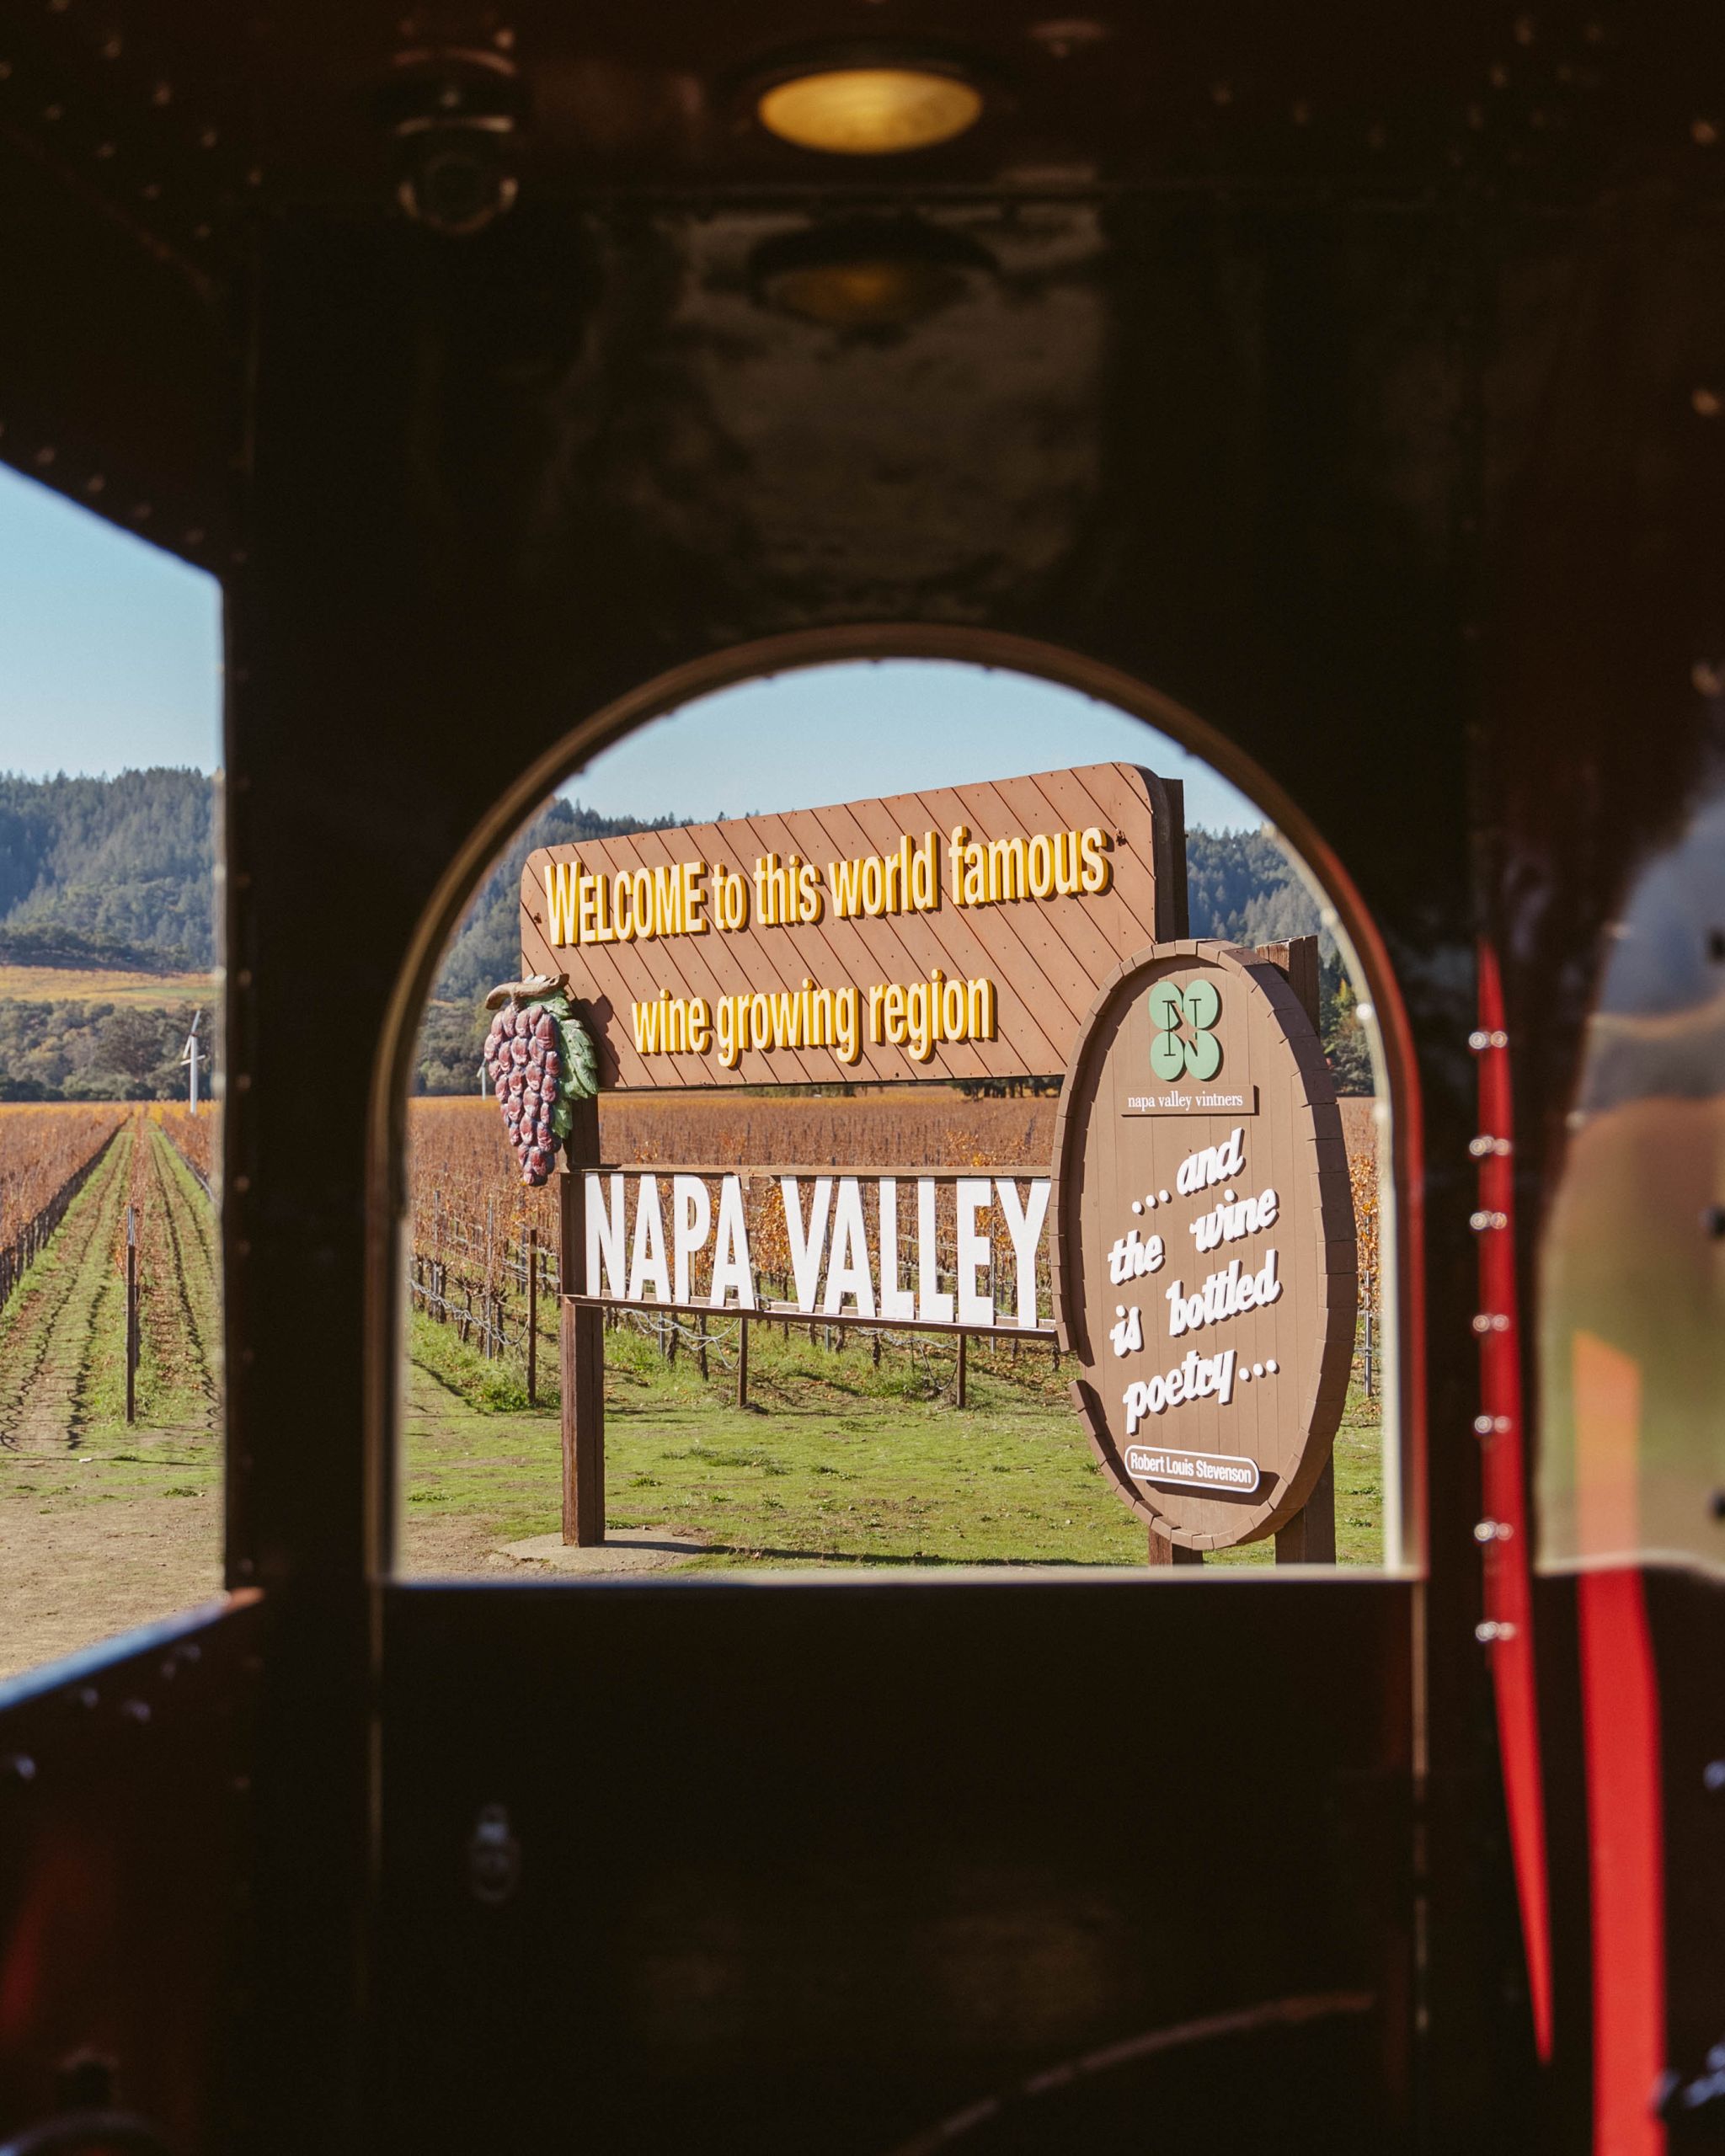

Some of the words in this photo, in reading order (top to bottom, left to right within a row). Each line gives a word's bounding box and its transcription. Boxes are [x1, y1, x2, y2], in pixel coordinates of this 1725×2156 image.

[712, 864, 746, 930] to
[754, 853, 821, 926] this
[829, 831, 938, 917] world
[948, 826, 1108, 905] famous
[632, 989, 710, 1054] wine
[718, 978, 858, 1067] growing
[869, 969, 993, 1061] region
[1128, 1097, 1156, 1112] napa
[1158, 1091, 1192, 1111] valley
[1195, 1091, 1243, 1107] vintners
[585, 1172, 756, 1310] NAPA
[780, 1175, 1052, 1328] VALLEY
[1108, 1230, 1164, 1284] the
[1189, 1188, 1277, 1252] wine
[1109, 1305, 1142, 1357] is
[1166, 1249, 1280, 1336] bottled
[1130, 1452, 1165, 1473] Robert
[1166, 1458, 1194, 1477] Louis
[1195, 1460, 1252, 1483] Stevenson
